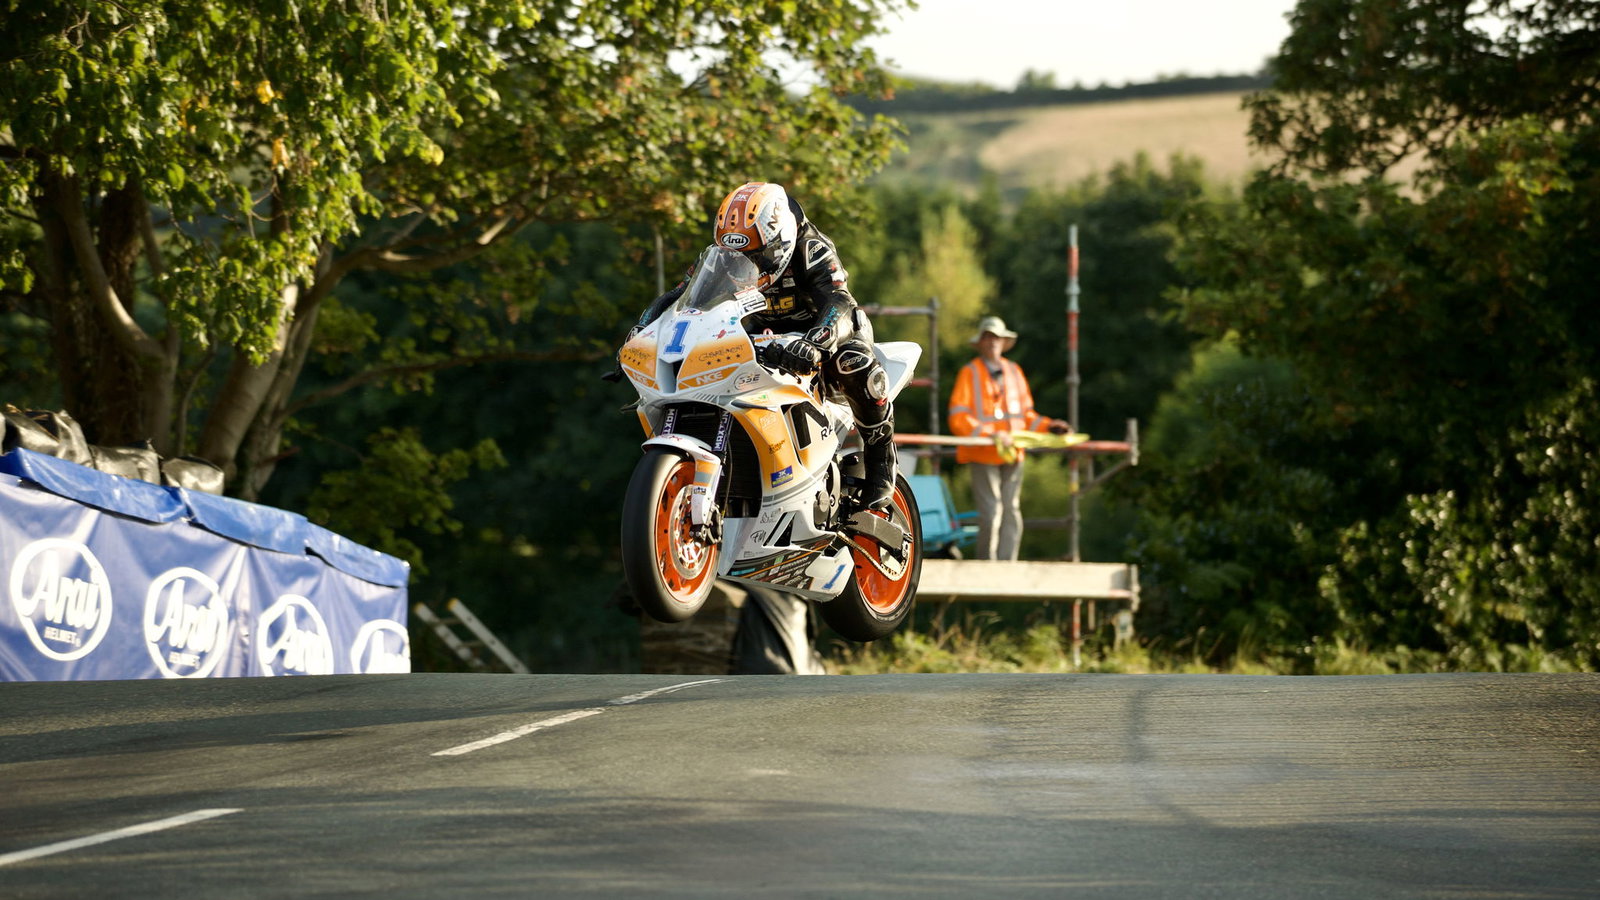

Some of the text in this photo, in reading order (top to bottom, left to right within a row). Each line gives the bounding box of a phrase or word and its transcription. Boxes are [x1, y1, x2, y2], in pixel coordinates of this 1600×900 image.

[724, 234, 746, 244] Arai
[664, 320, 691, 355] 1
[662, 408, 677, 435] MAXT
[20, 549, 100, 630] Arai
[821, 564, 847, 590] 1
[43, 626, 79, 645] HELMET
